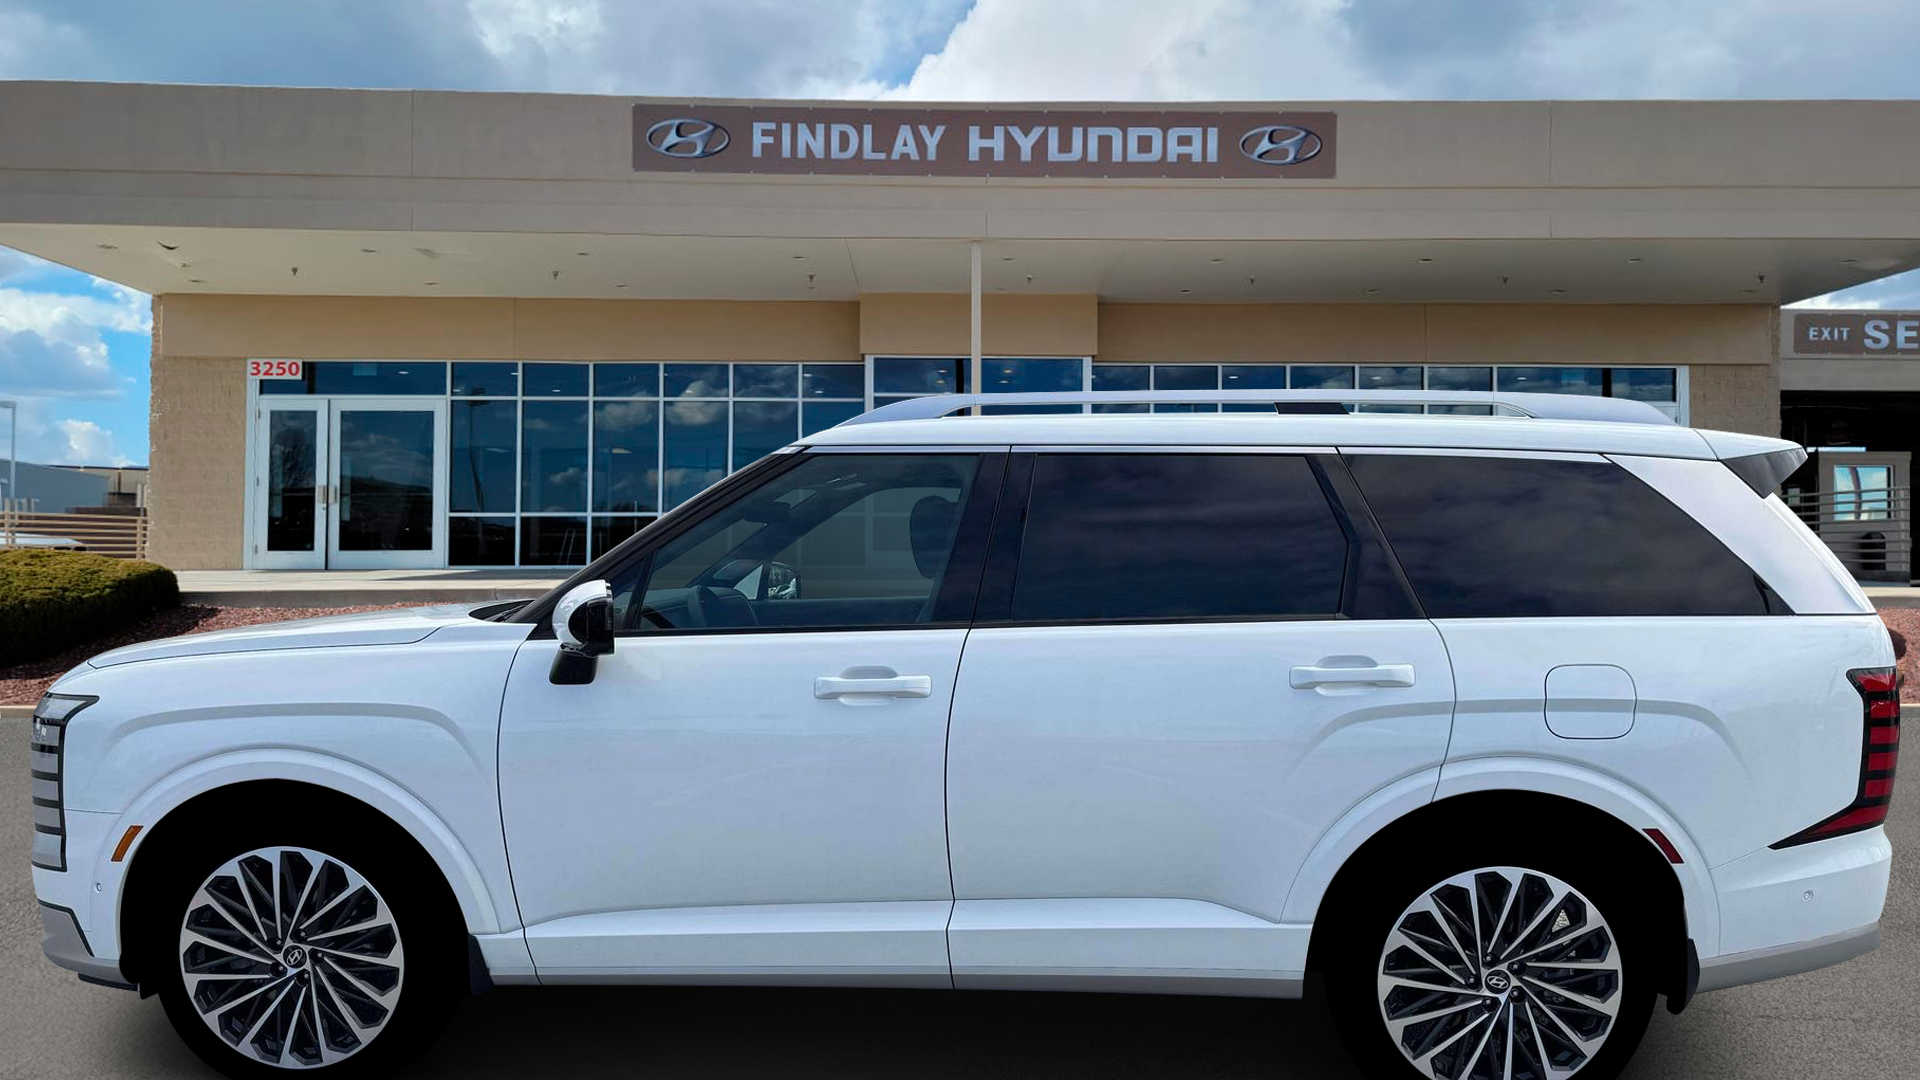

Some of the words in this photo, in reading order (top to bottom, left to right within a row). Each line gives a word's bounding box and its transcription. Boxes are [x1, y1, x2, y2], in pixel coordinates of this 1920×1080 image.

[752, 121, 946, 162] FINDLAY
[968, 126, 1219, 163] HYUNDAI
[1809, 327, 1850, 341] EXIT
[250, 361, 300, 376] 3250
